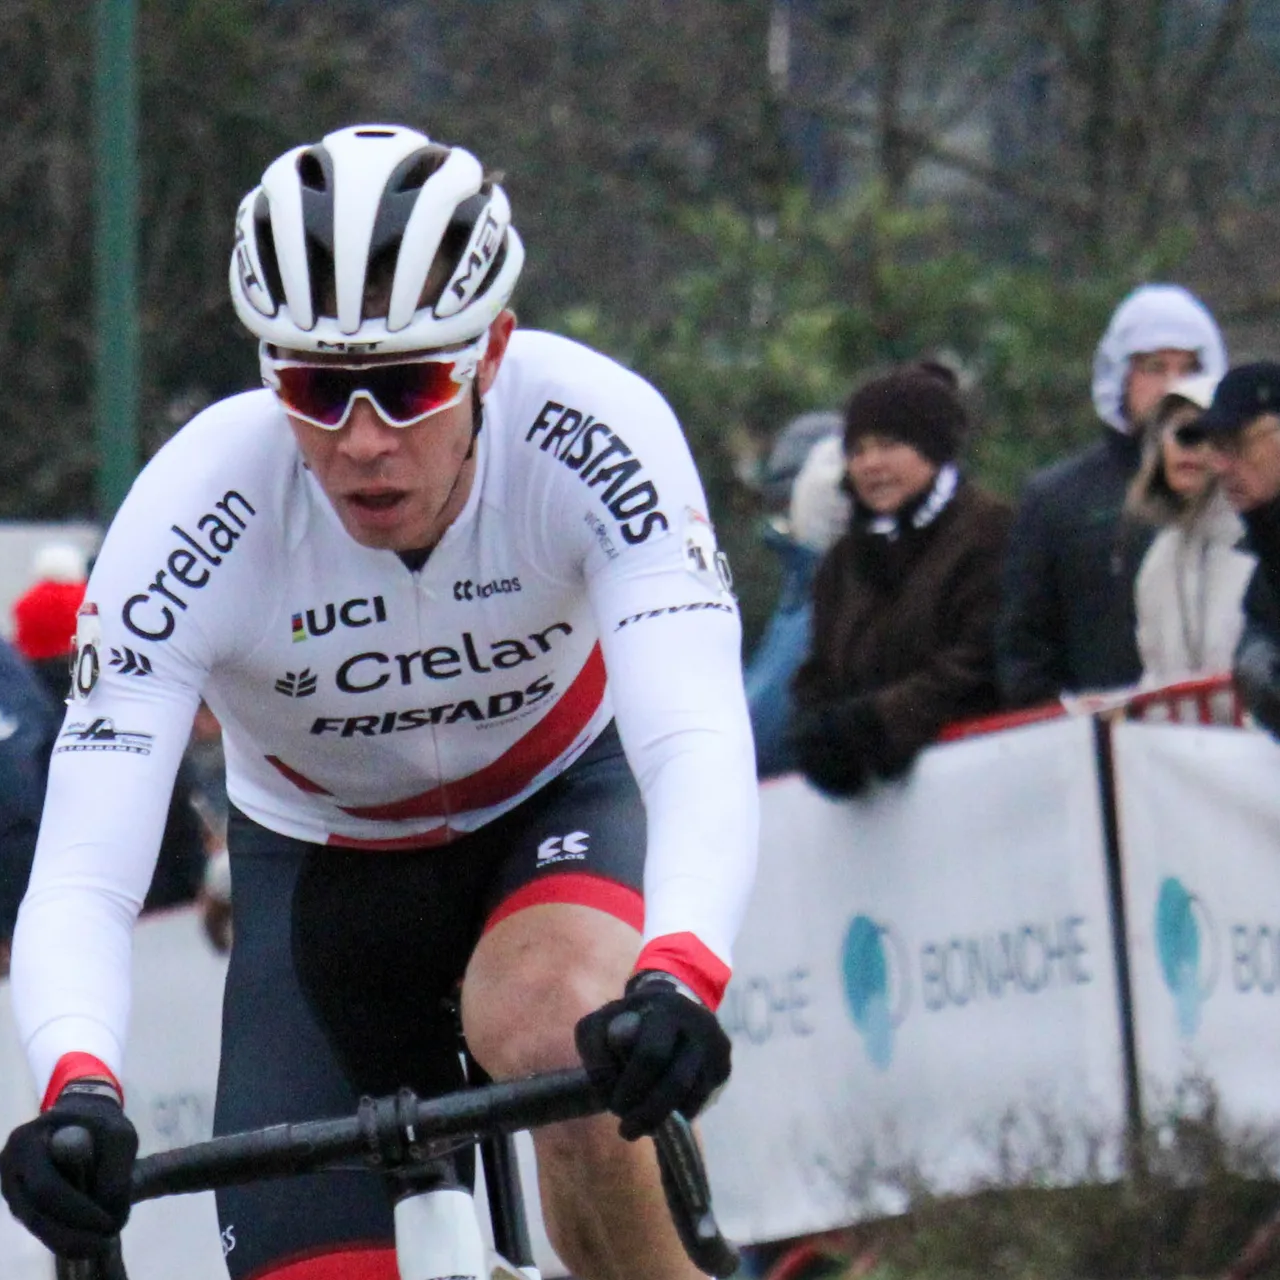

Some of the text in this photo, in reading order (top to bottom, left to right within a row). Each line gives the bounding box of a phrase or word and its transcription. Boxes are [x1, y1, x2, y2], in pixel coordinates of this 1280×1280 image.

[524, 399, 669, 545] FRISTADS
[121, 489, 256, 642] Crelan
[306, 595, 387, 637] UCI
[335, 621, 573, 694] Crelan
[309, 673, 556, 738] FRISTADS
[922, 914, 1093, 1011] BONACHE
